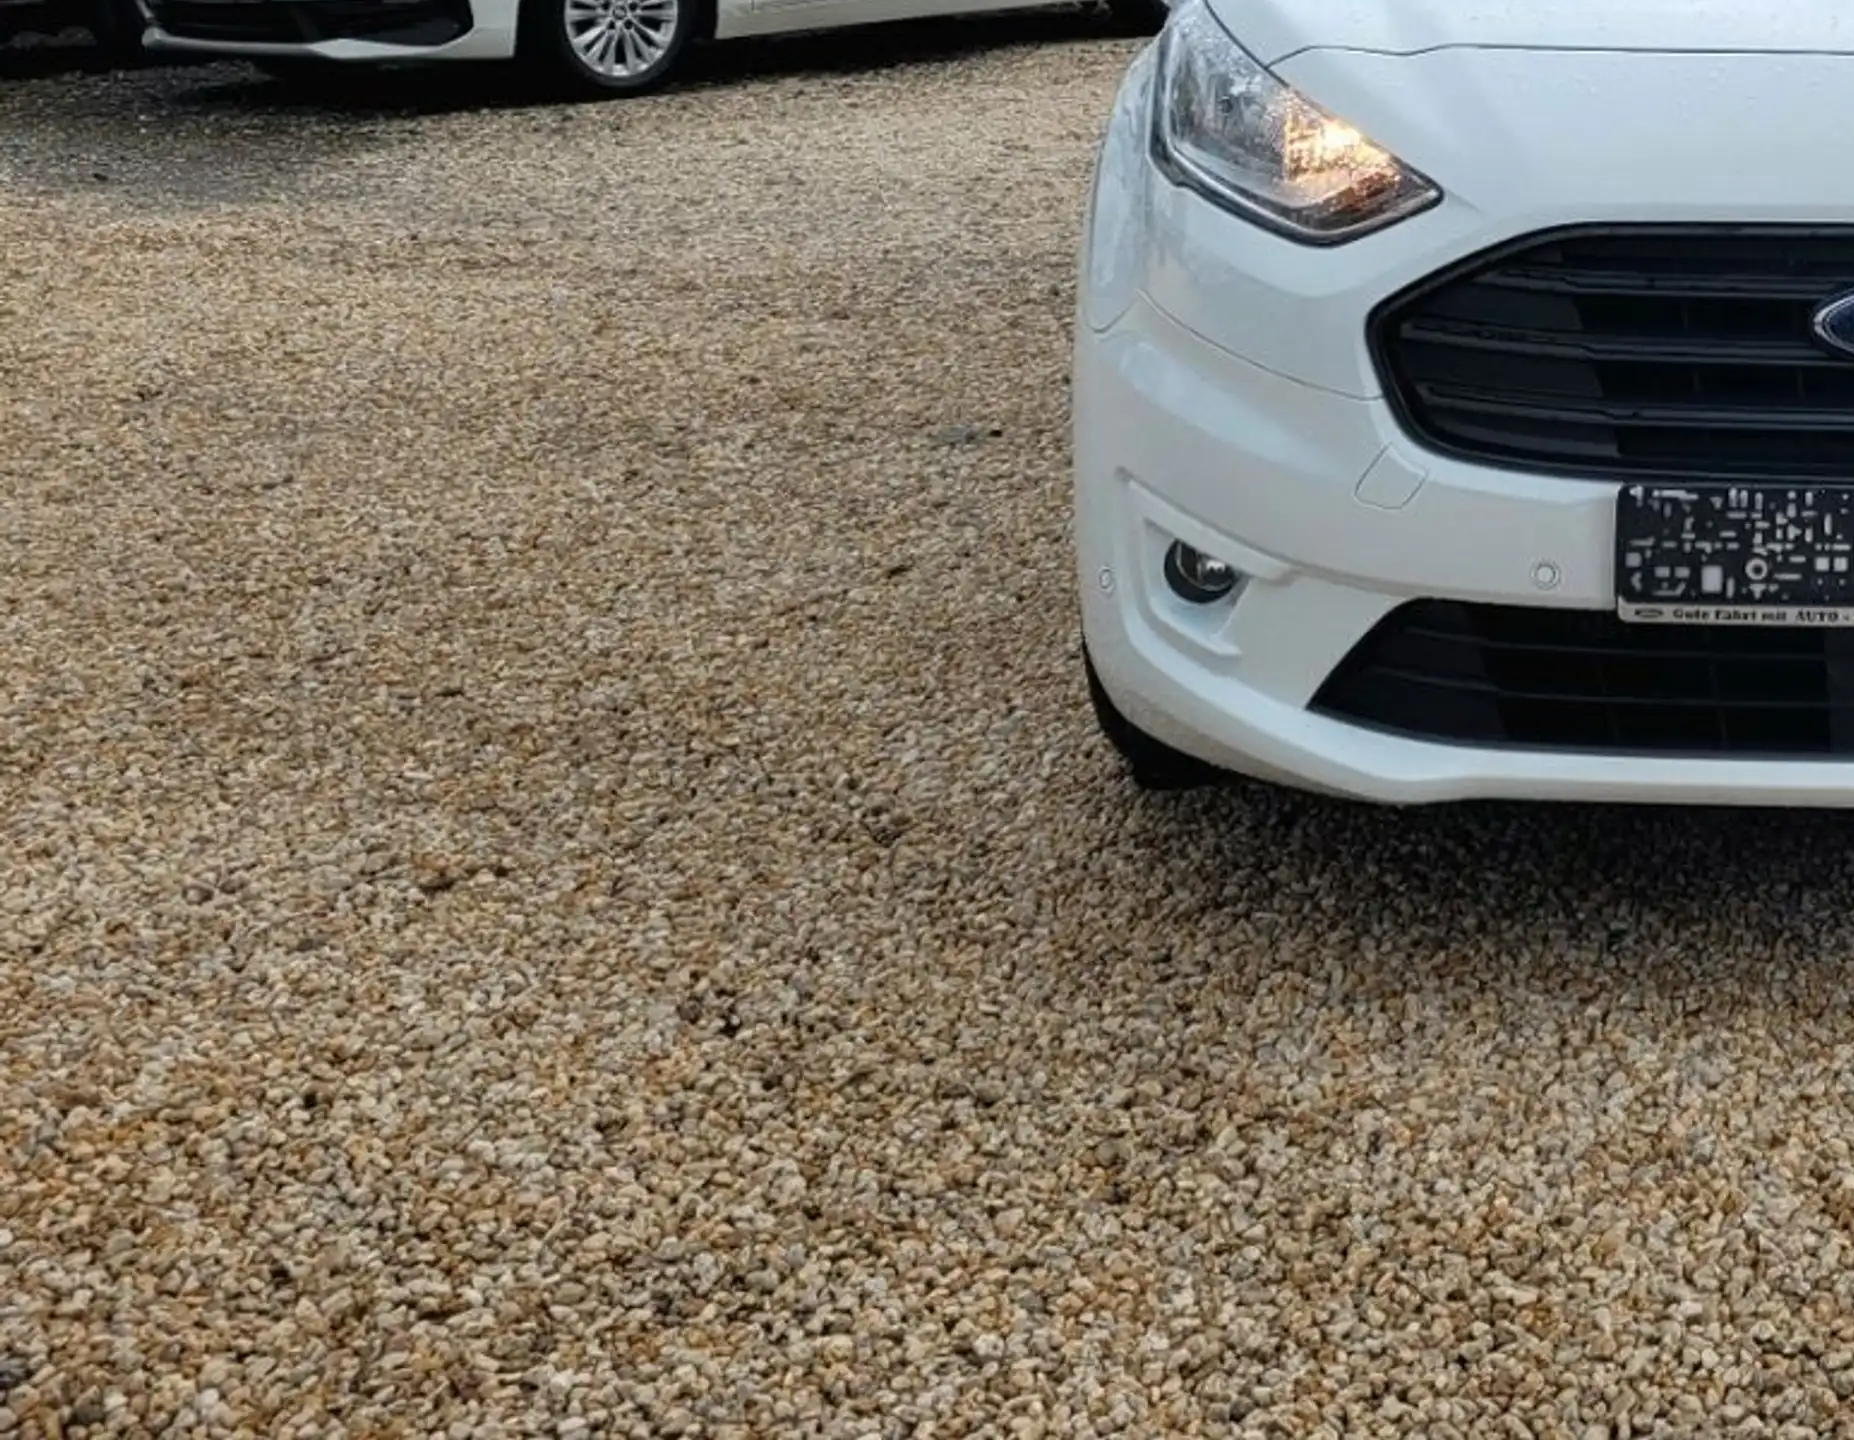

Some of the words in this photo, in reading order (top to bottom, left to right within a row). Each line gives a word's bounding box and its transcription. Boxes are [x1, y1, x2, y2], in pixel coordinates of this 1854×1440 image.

[1673, 608, 1710, 622] Gute
[1761, 610, 1787, 623] mit
[1795, 610, 1839, 624] AUTO
